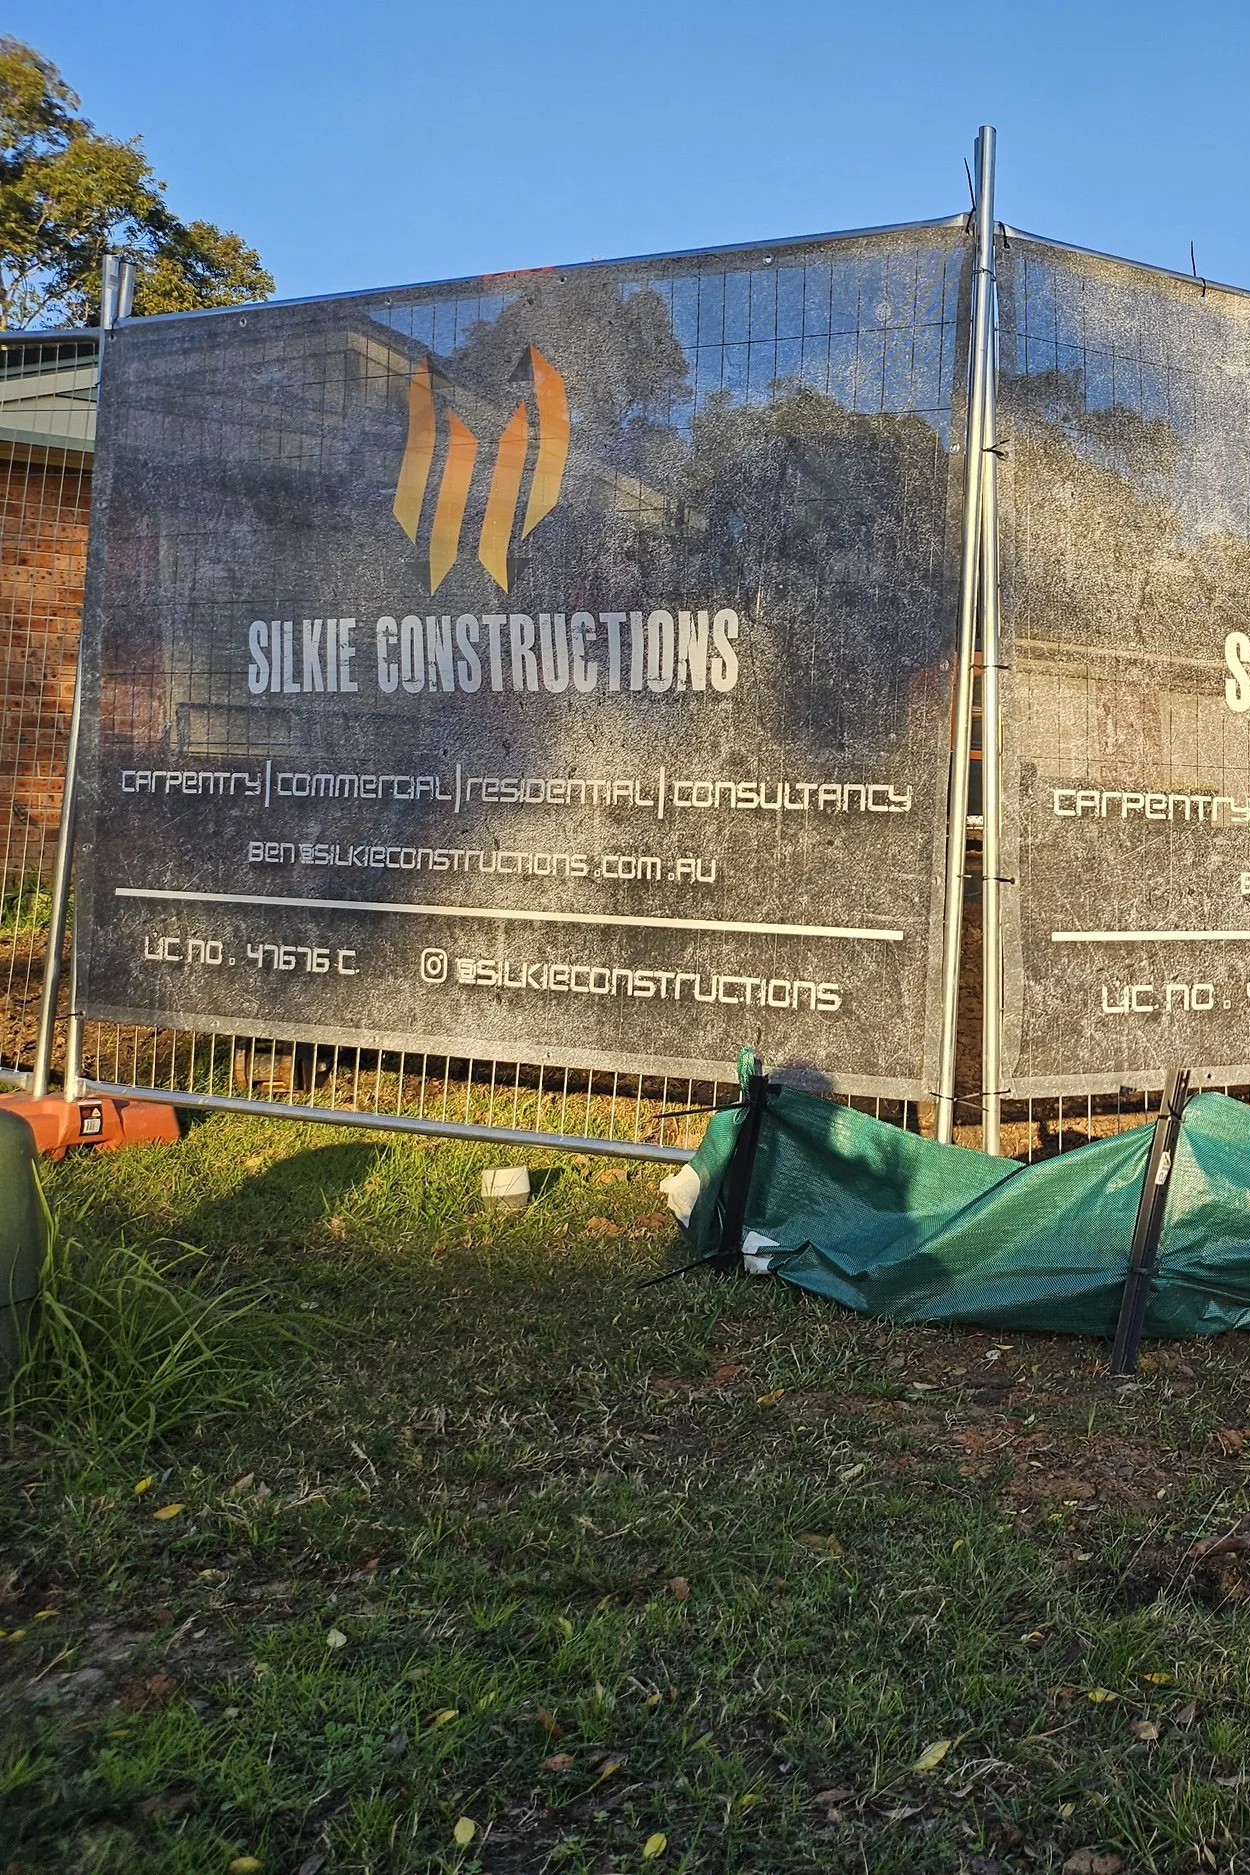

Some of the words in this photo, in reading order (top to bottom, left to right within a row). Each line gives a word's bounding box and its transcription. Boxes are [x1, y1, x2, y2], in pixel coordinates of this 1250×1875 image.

[248, 617, 358, 695] SILKIE
[376, 608, 739, 695] CONSTRUCTIONS
[246, 943, 330, 973] 47676
